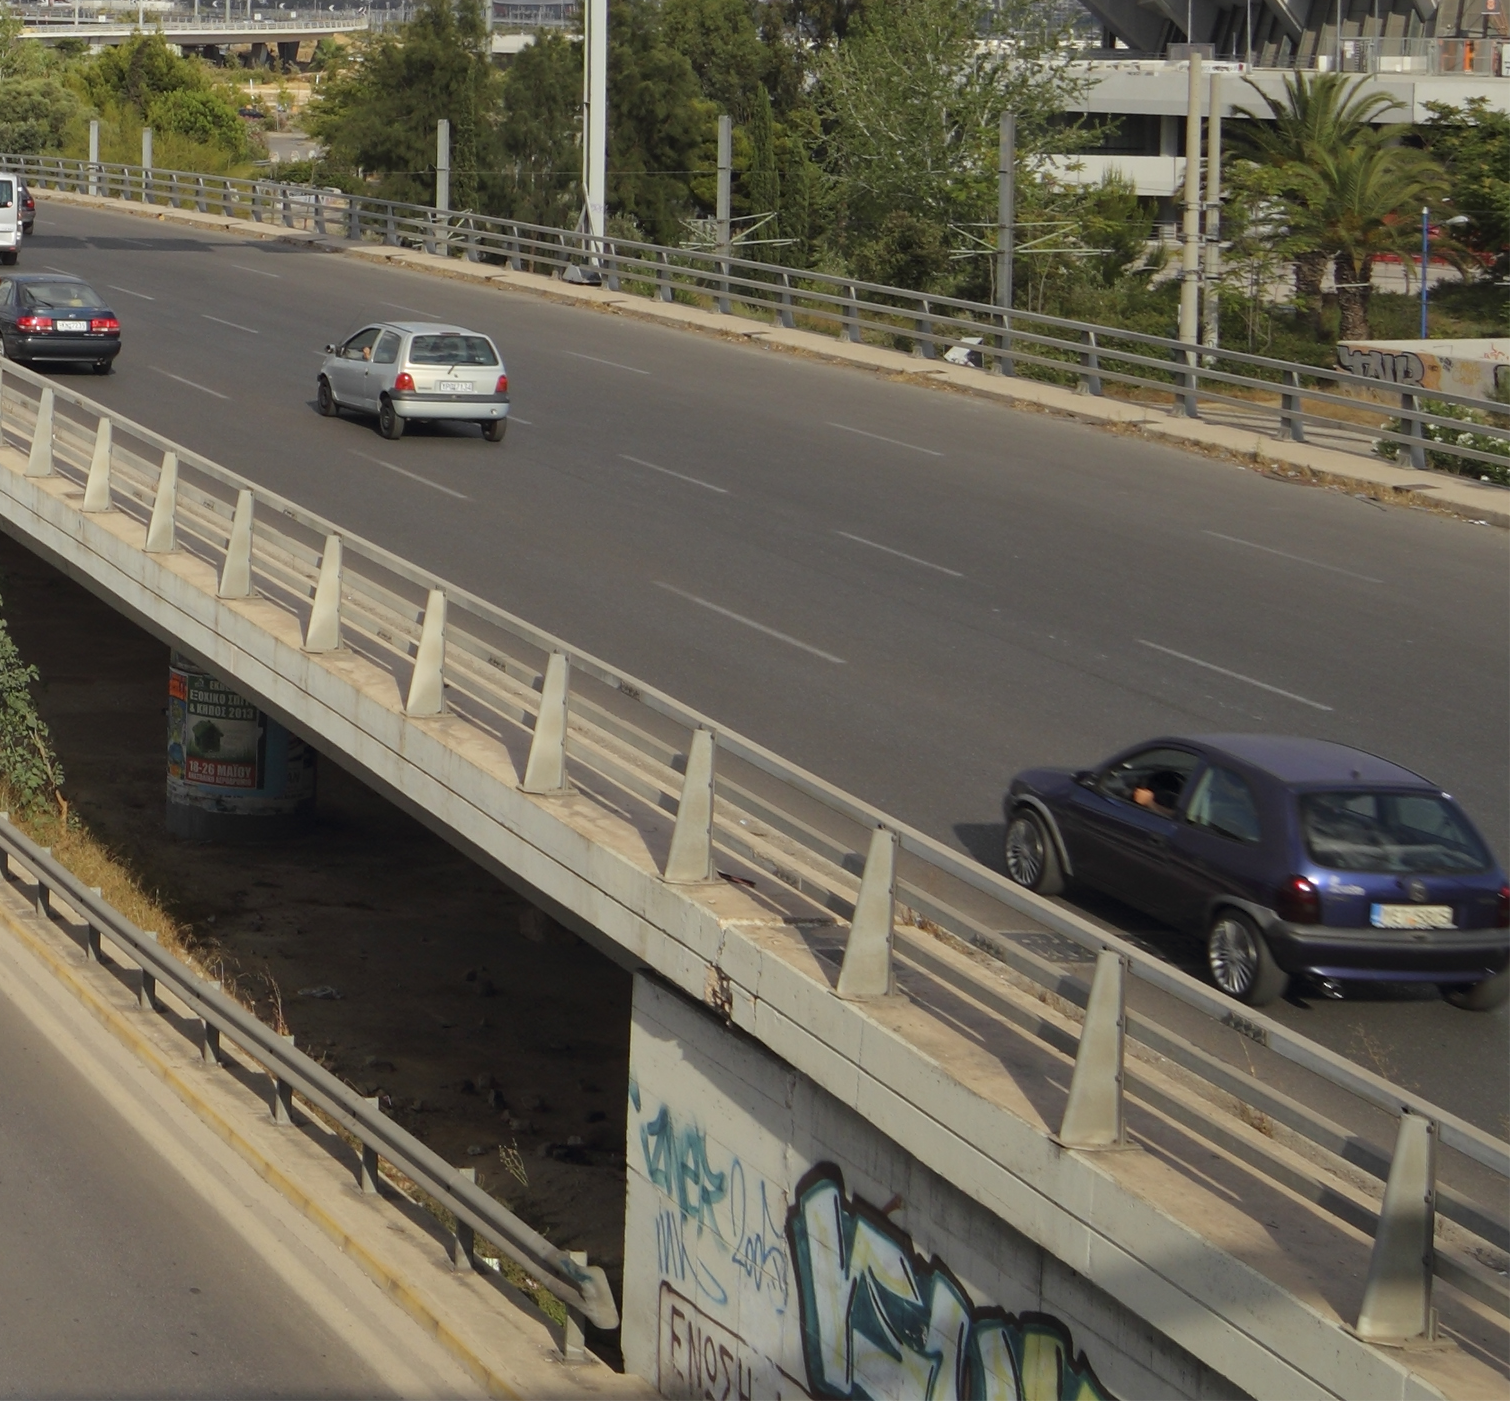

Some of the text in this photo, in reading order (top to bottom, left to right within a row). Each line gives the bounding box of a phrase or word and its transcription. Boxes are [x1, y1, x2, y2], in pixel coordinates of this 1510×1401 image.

[190, 689, 226, 704] ΕΞΟΧΙΚΟ
[197, 704, 226, 717] ΚΗΠΟΣ
[228, 707, 253, 719] 2013
